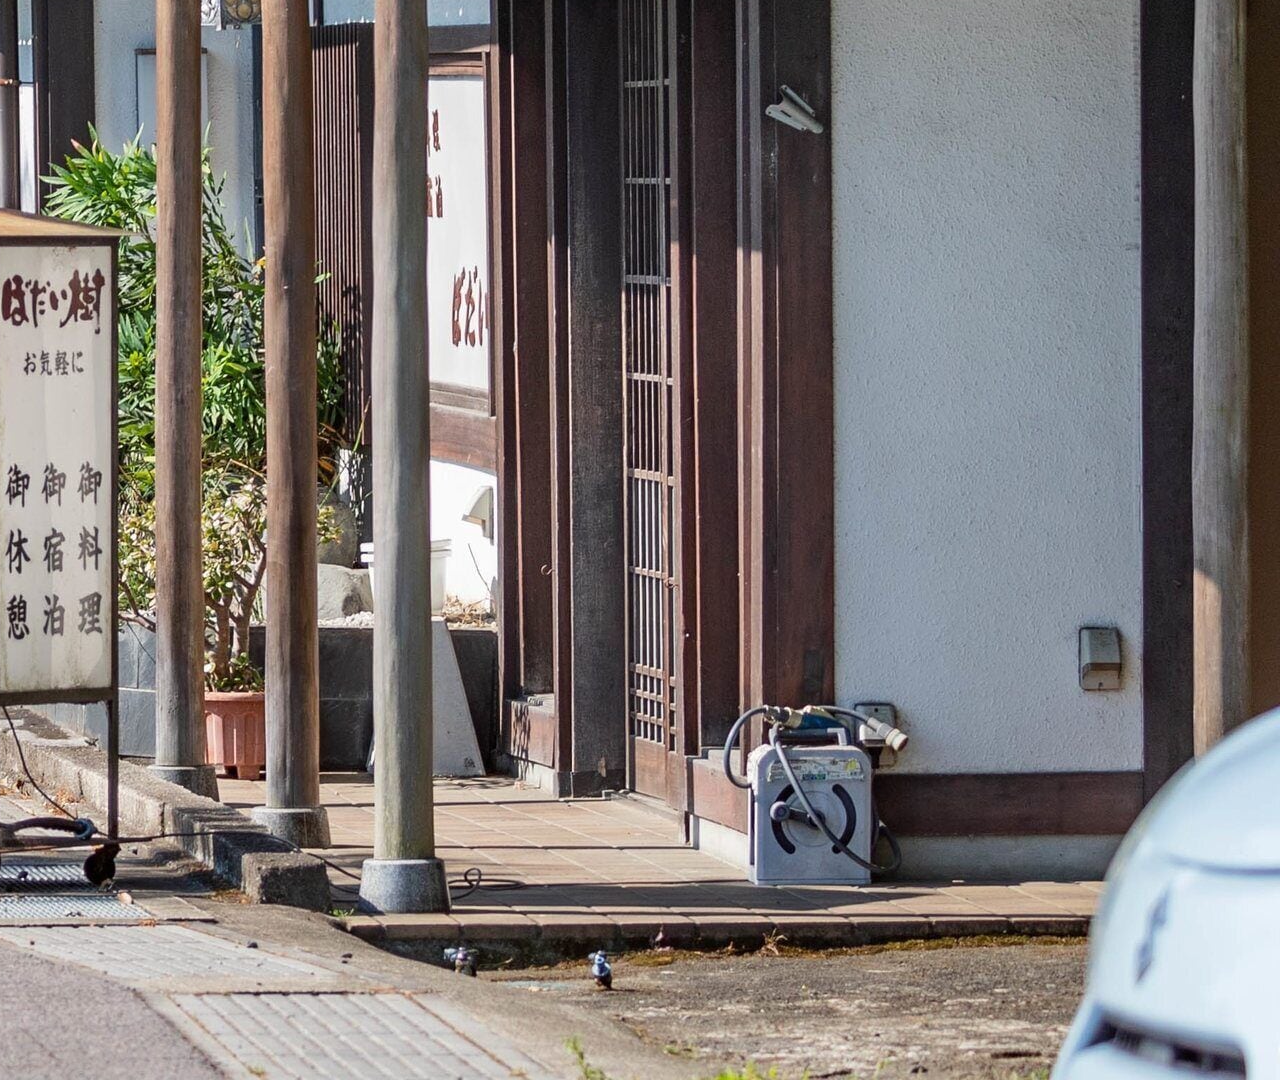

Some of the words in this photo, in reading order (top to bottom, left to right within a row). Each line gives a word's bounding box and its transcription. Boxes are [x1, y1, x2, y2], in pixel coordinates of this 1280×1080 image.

[1, 268, 106, 335] ぼだい樹
[23, 350, 84, 376] お気軽に
[5, 463, 31, 641] 御休憩
[41, 462, 67, 637] 御宿泊
[77, 461, 103, 636] 御料理
